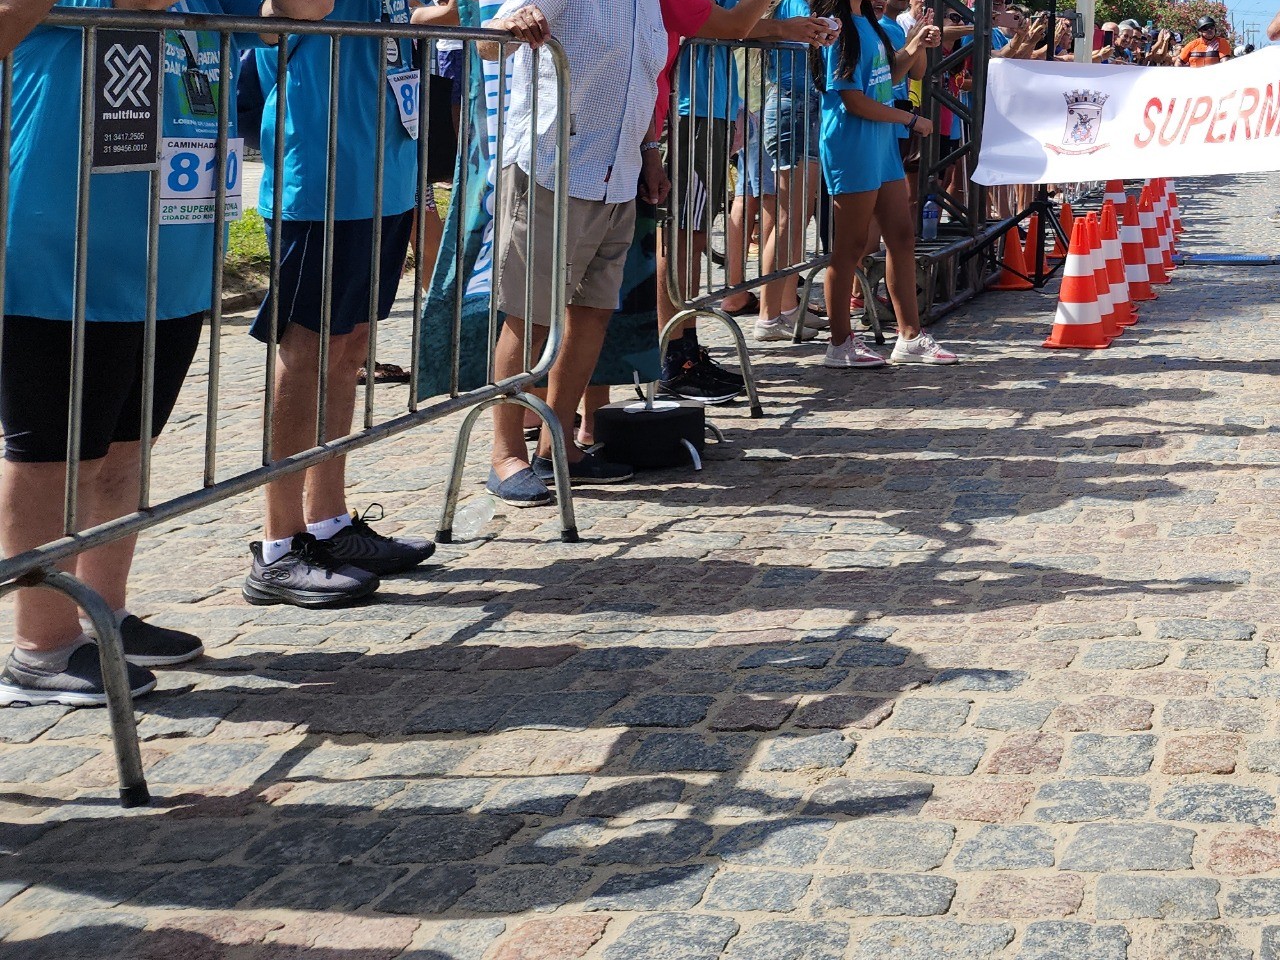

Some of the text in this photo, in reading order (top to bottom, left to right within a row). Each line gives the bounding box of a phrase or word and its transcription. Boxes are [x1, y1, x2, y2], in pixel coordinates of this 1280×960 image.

[102, 109, 151, 120] multfluxo
[104, 133, 112, 142] 31
[103, 145, 112, 154] 31
